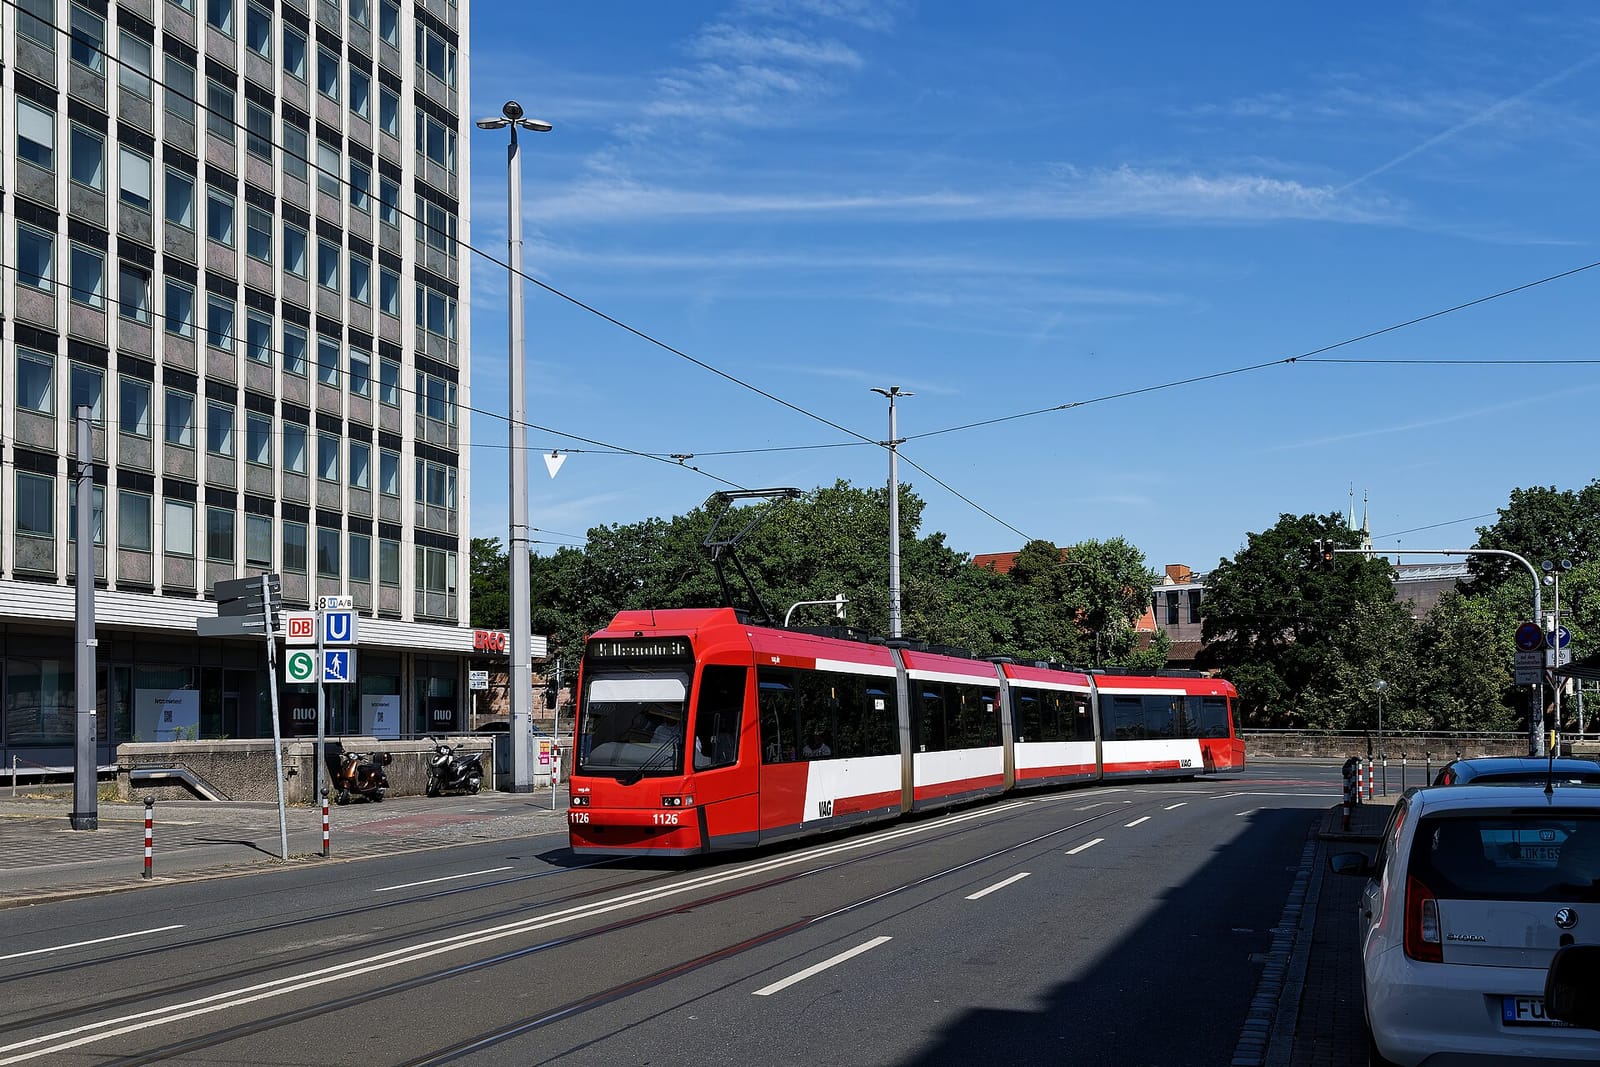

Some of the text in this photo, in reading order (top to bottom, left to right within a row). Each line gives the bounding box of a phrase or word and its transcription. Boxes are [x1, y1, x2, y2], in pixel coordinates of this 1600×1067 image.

[319, 597, 326, 609] 8
[291, 621, 311, 635] DB
[330, 615, 347, 639] U
[473, 630, 506, 651] ERGO
[294, 656, 308, 676] S
[1180, 759, 1192, 767] VAG
[818, 800, 832, 817] VAG
[570, 813, 589, 824] 1126
[653, 814, 679, 825] 1126
